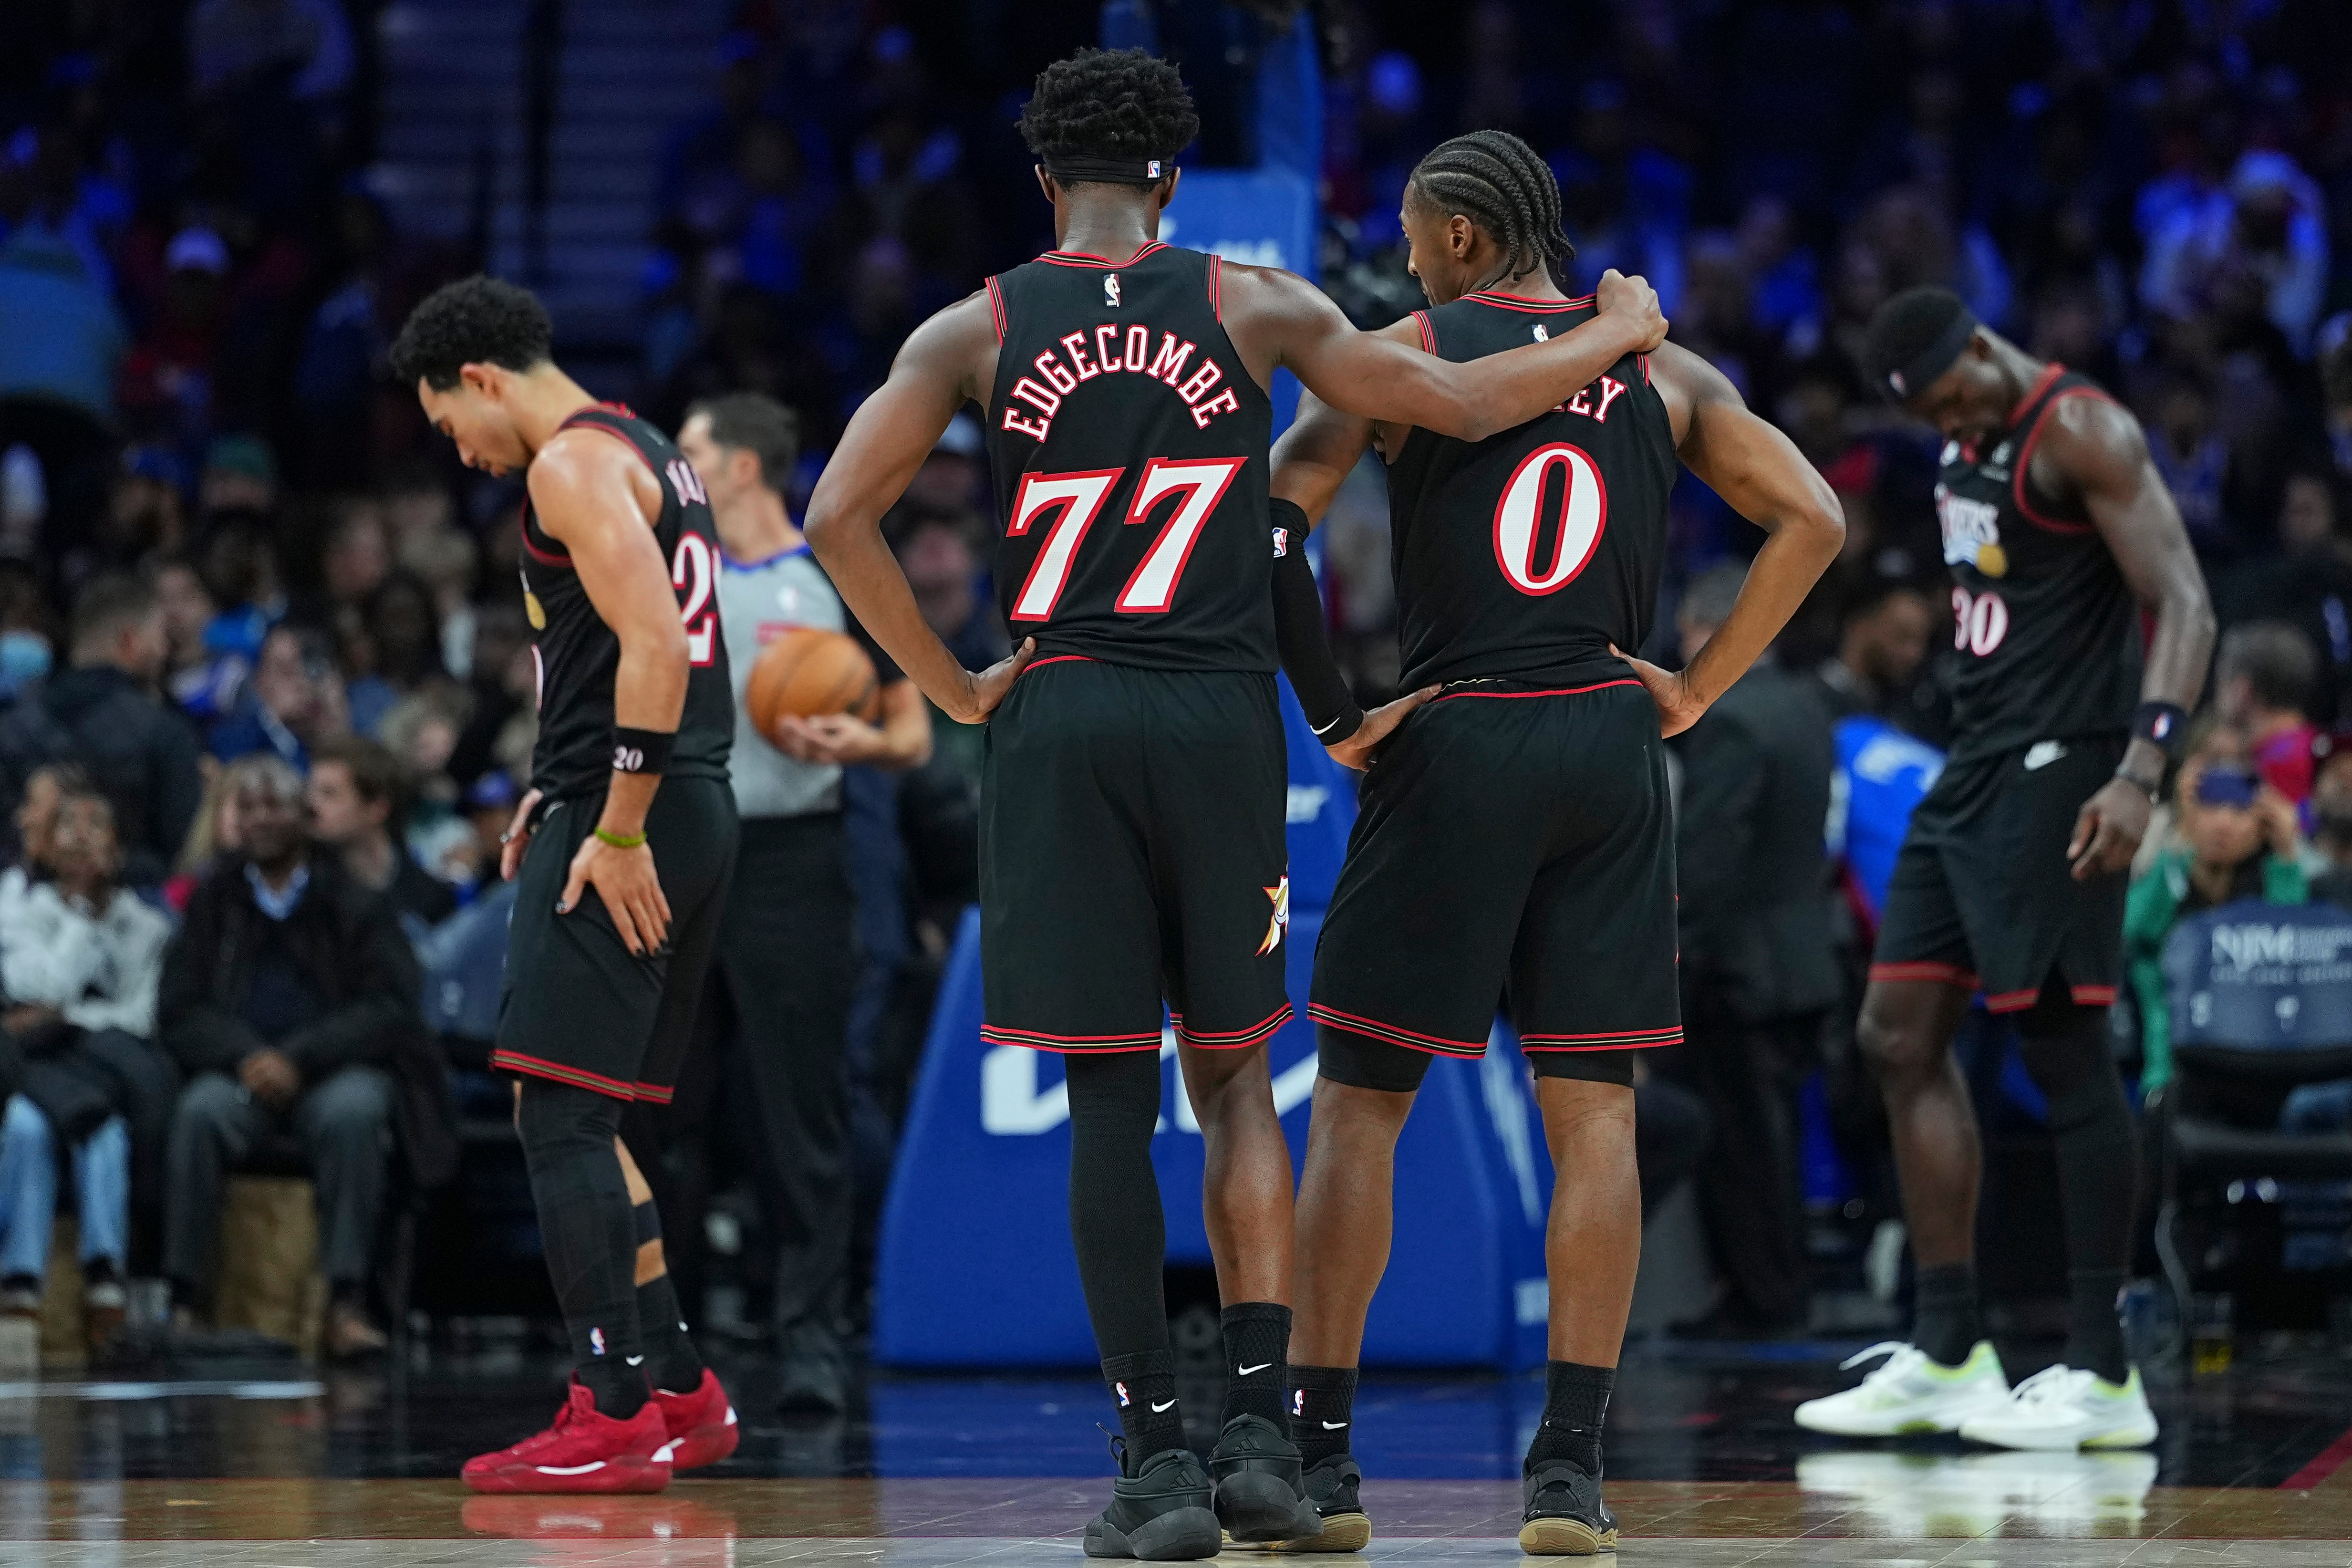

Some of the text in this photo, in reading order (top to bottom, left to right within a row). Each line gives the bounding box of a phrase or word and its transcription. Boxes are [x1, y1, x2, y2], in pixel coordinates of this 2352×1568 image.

[1002, 324, 1240, 443] EDGECOMBE
[1550, 375, 1627, 424] EY
[1006, 456, 1249, 621] 77
[1492, 442, 1607, 596] 0
[672, 530, 723, 668] 2
[1951, 583, 2010, 657] 30
[612, 745, 643, 771] 20
